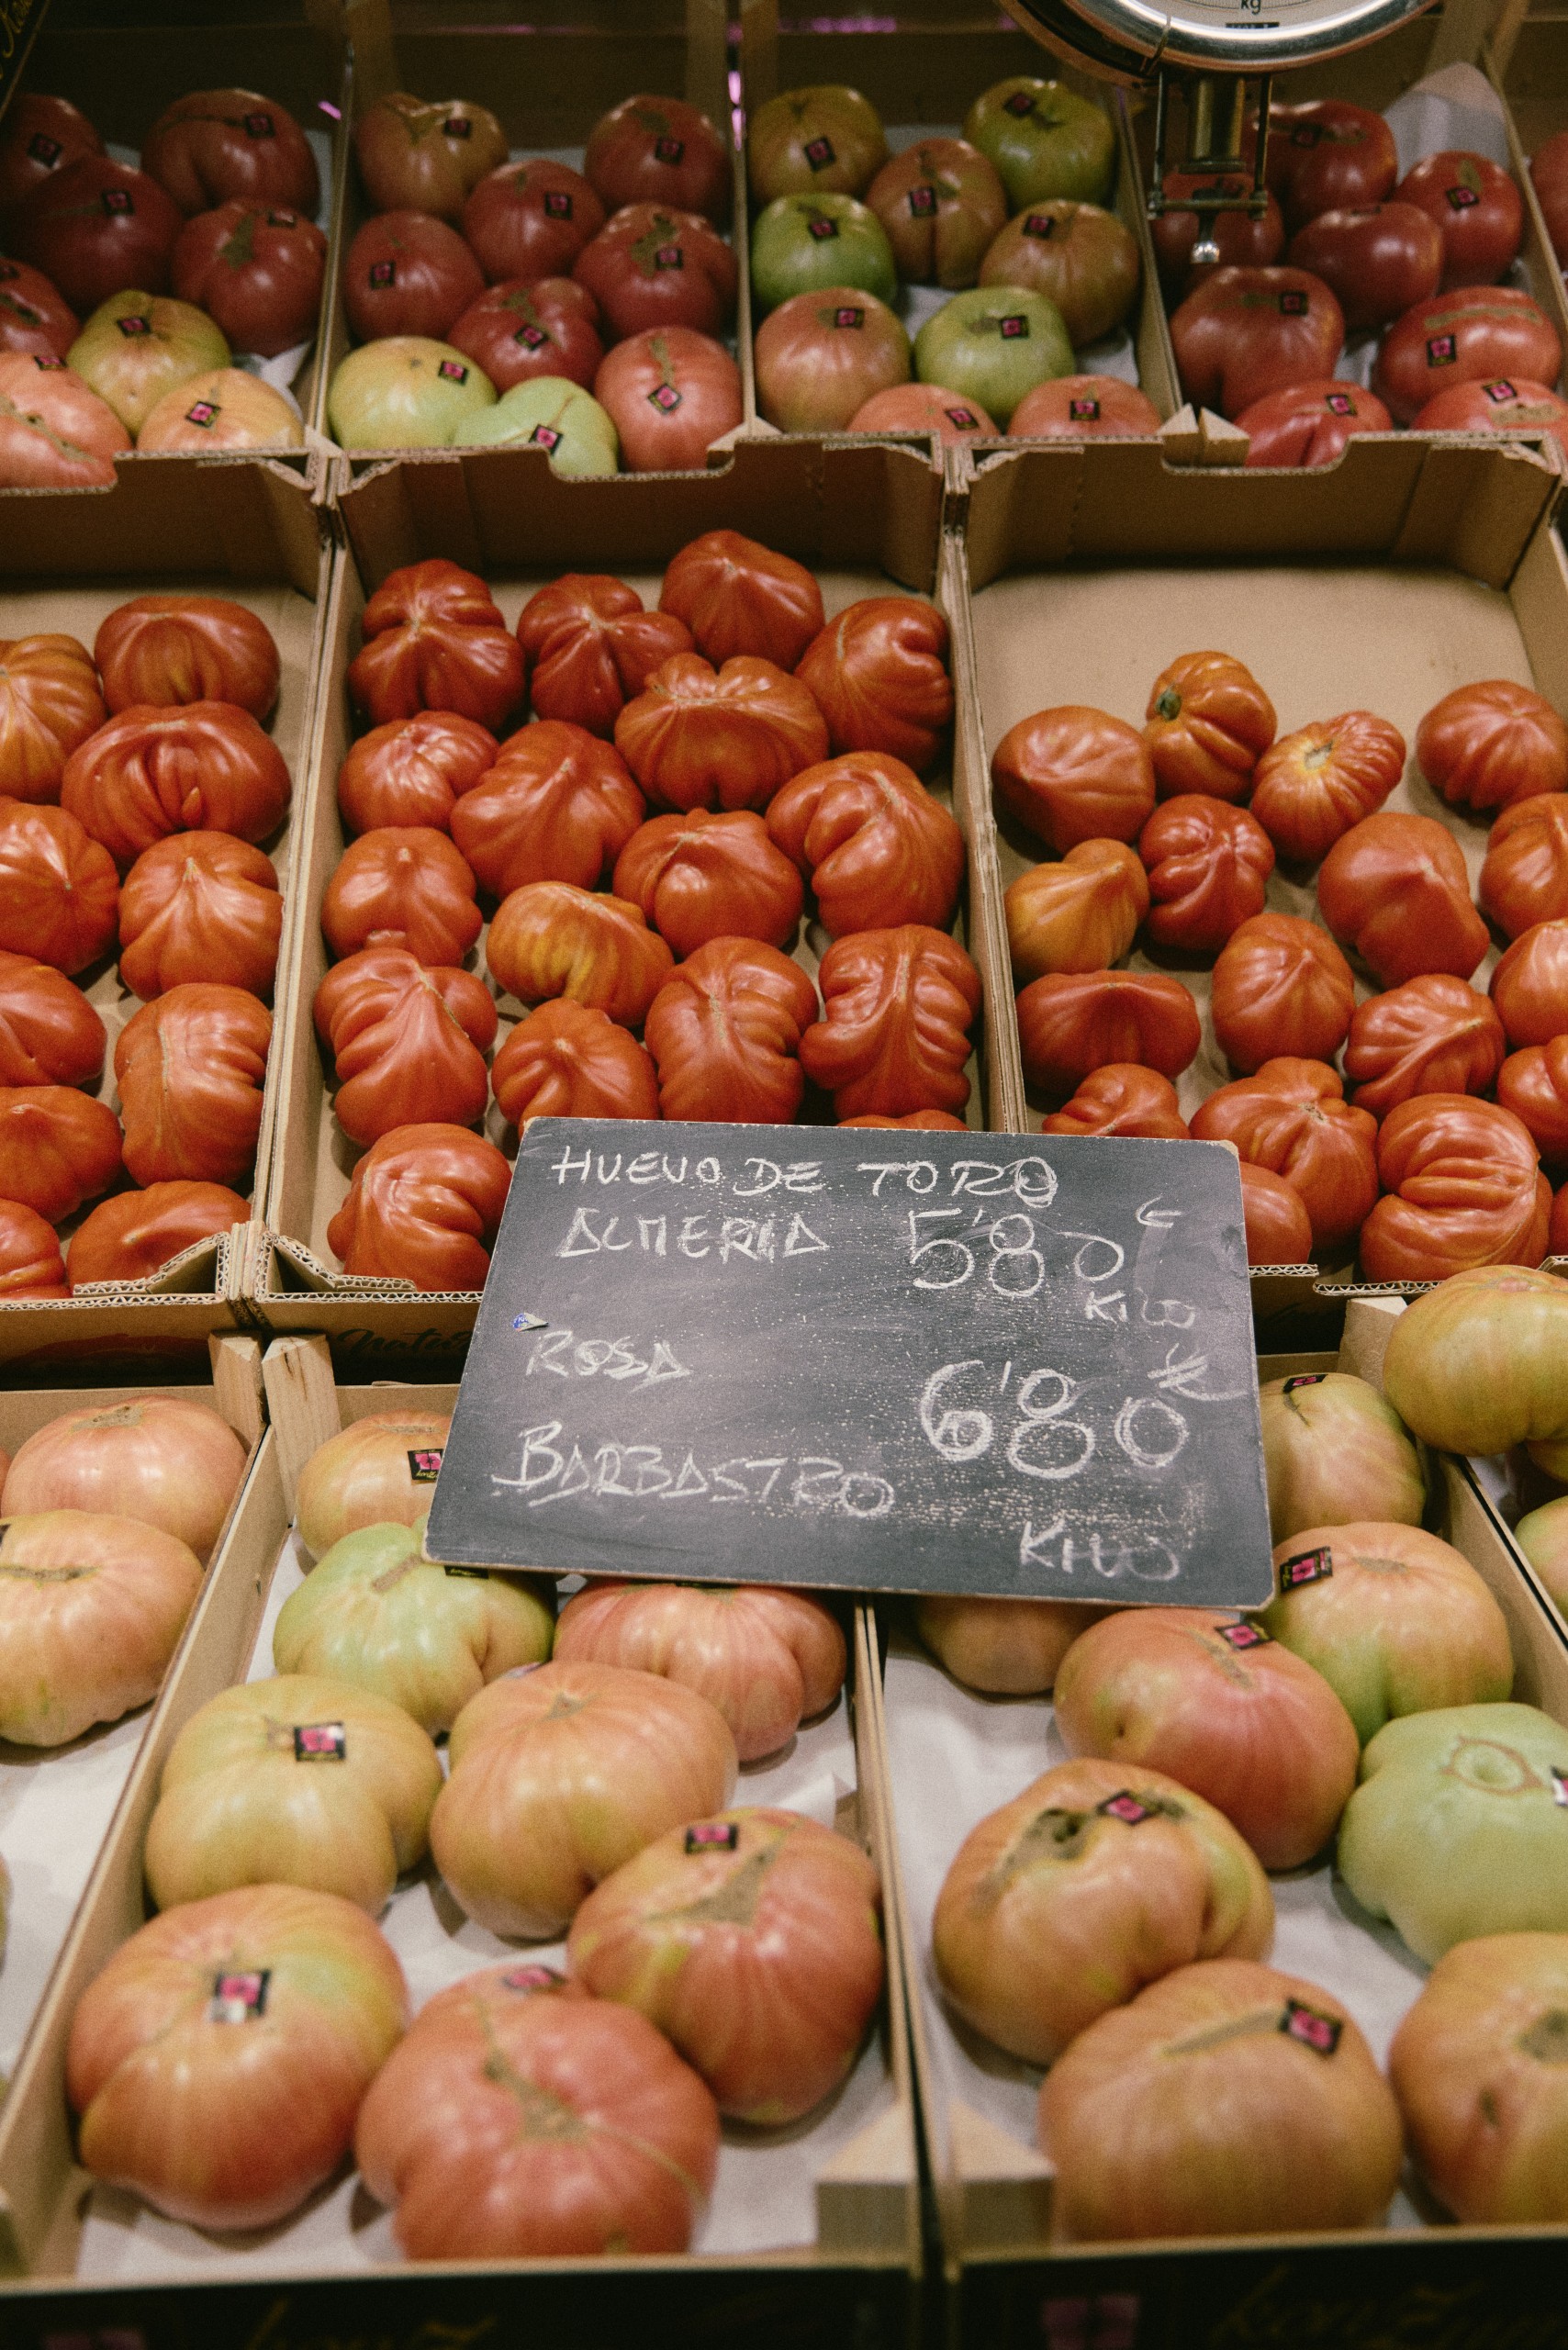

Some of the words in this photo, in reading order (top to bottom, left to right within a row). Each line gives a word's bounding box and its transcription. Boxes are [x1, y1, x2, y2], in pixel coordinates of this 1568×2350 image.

[733, 1157, 825, 1196] DE
[857, 1156, 1058, 1209] TORO
[526, 1330, 692, 1381] ROSA
[491, 1420, 895, 1517] BARBASTRO
